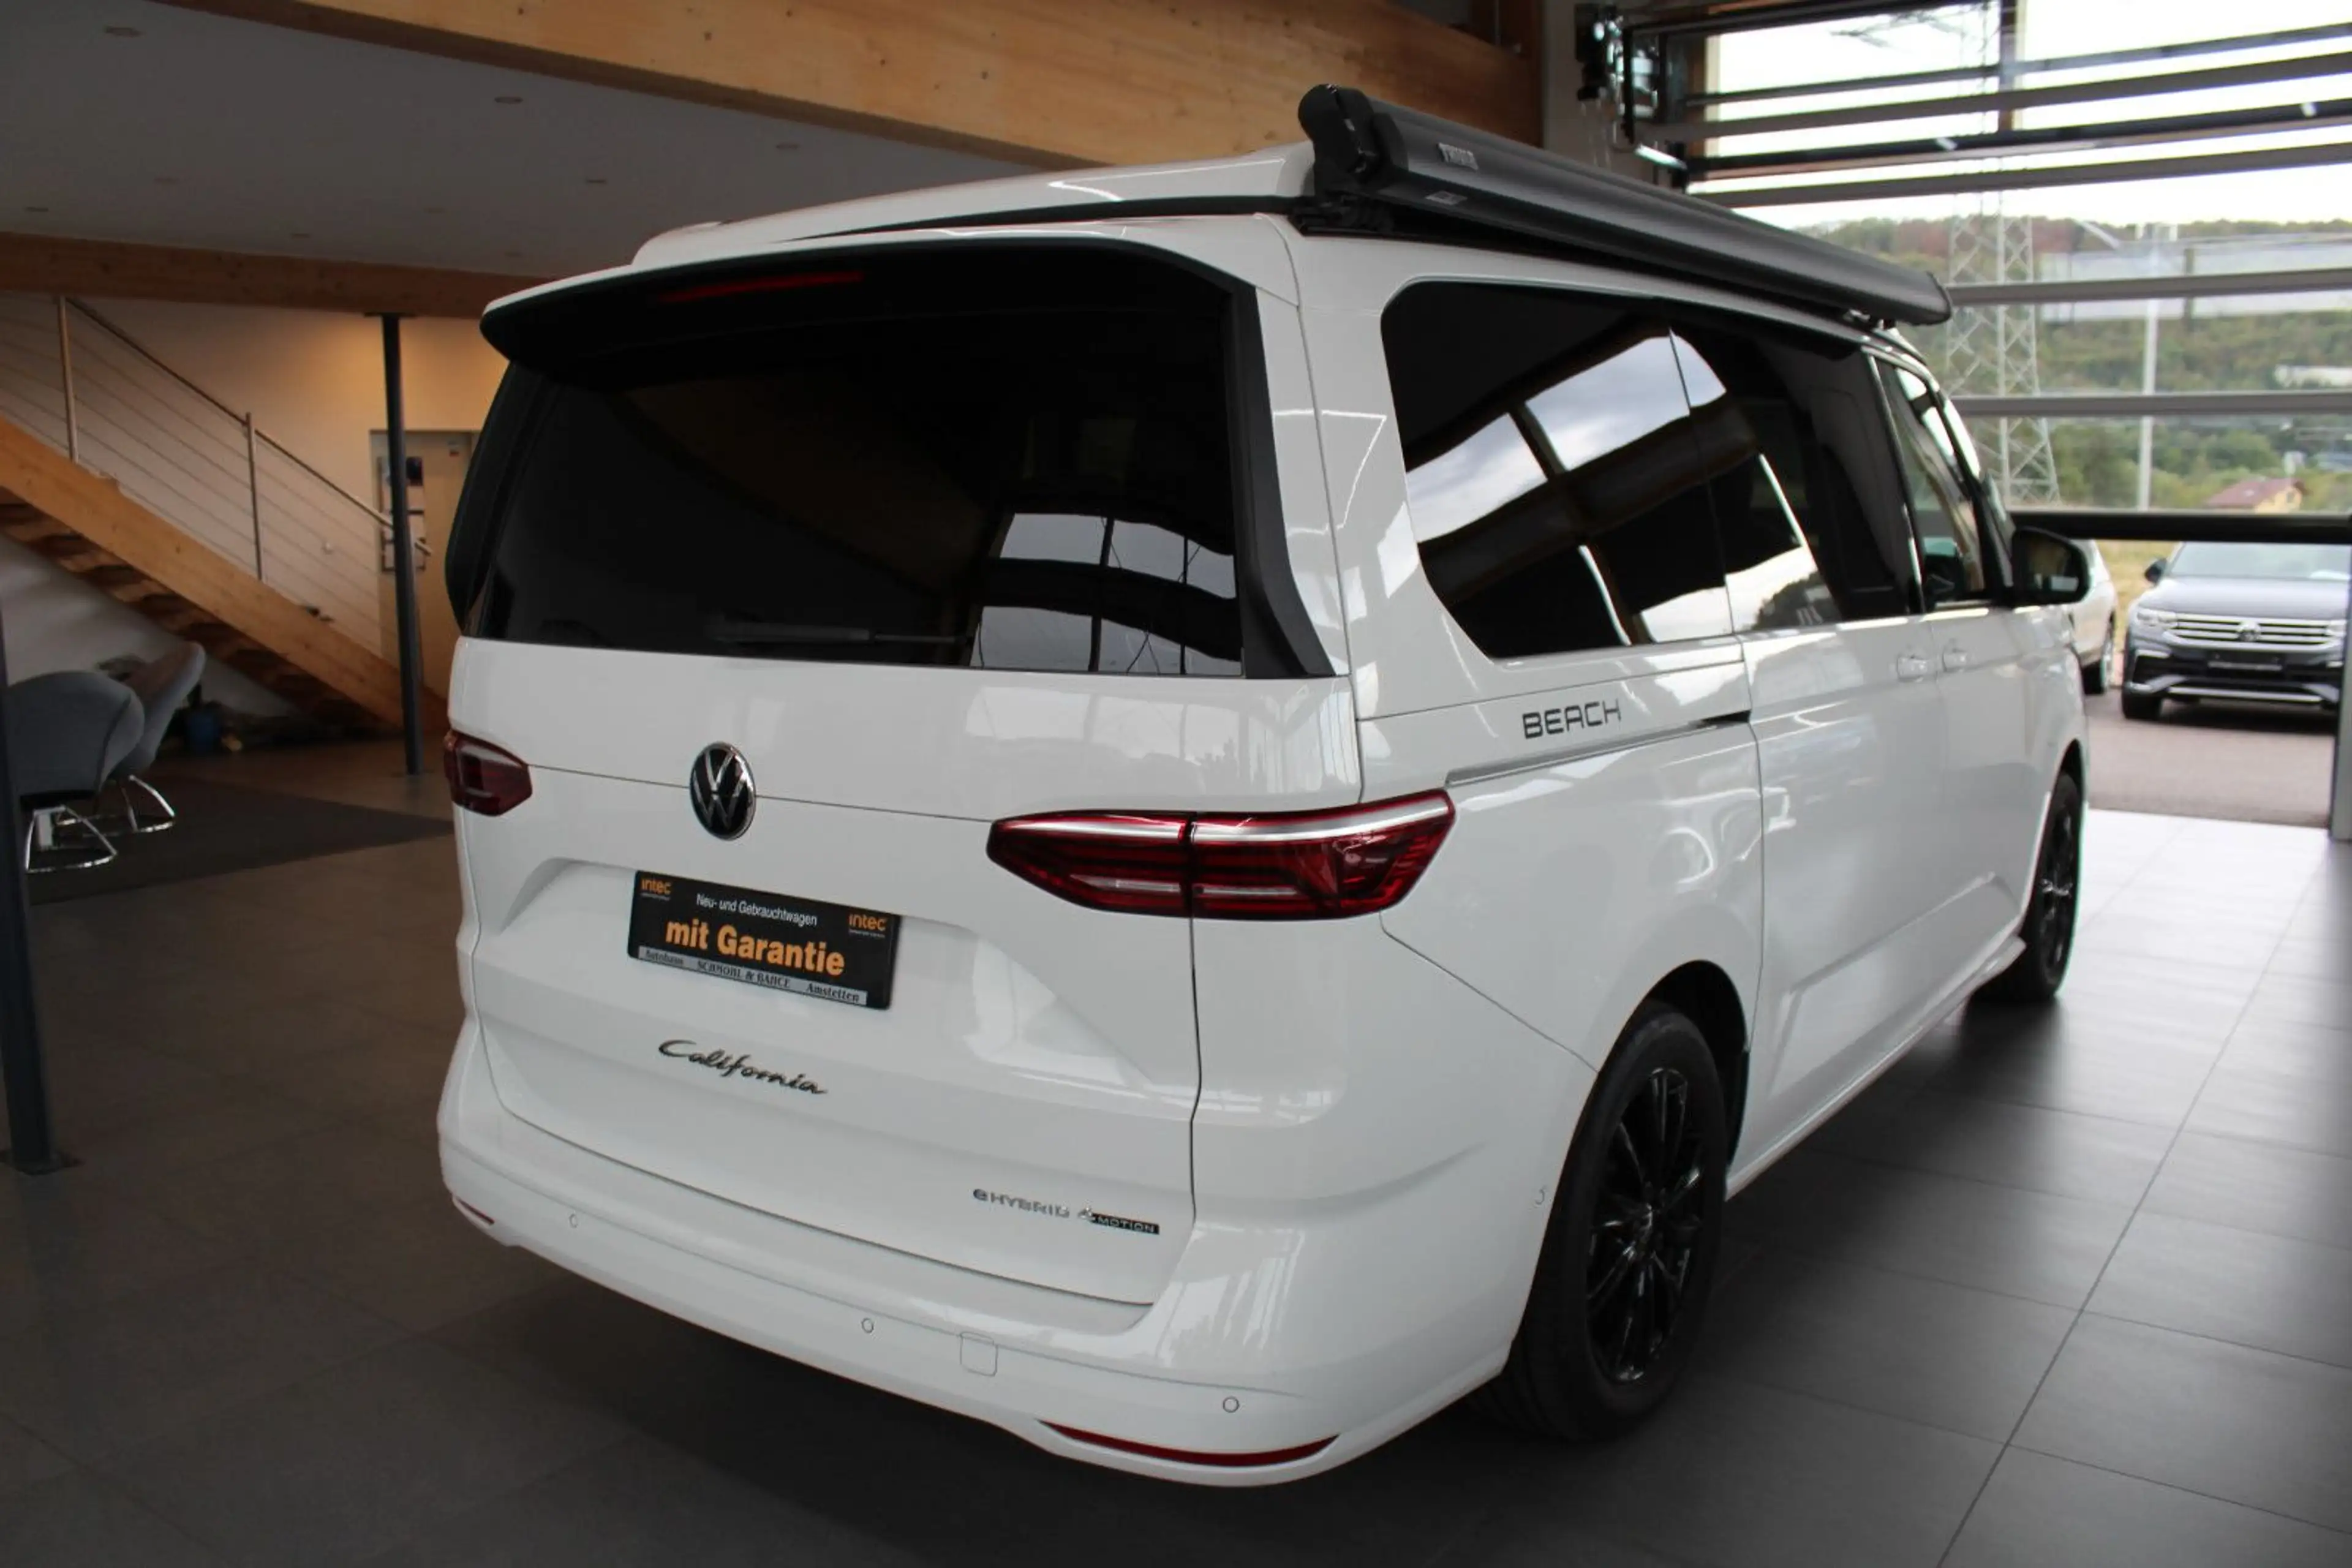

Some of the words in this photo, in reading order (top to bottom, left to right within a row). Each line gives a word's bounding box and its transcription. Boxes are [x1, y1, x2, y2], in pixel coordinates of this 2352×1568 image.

[1522, 698, 1621, 739] BEACH
[641, 878, 672, 895] intec
[696, 893, 717, 908] Neu-
[719, 900, 737, 912] und
[738, 900, 817, 927] Gebrauchtwagen
[849, 913, 888, 931] intec
[665, 918, 709, 949] mit
[717, 924, 845, 976] Garantie
[658, 1039, 828, 1095] California
